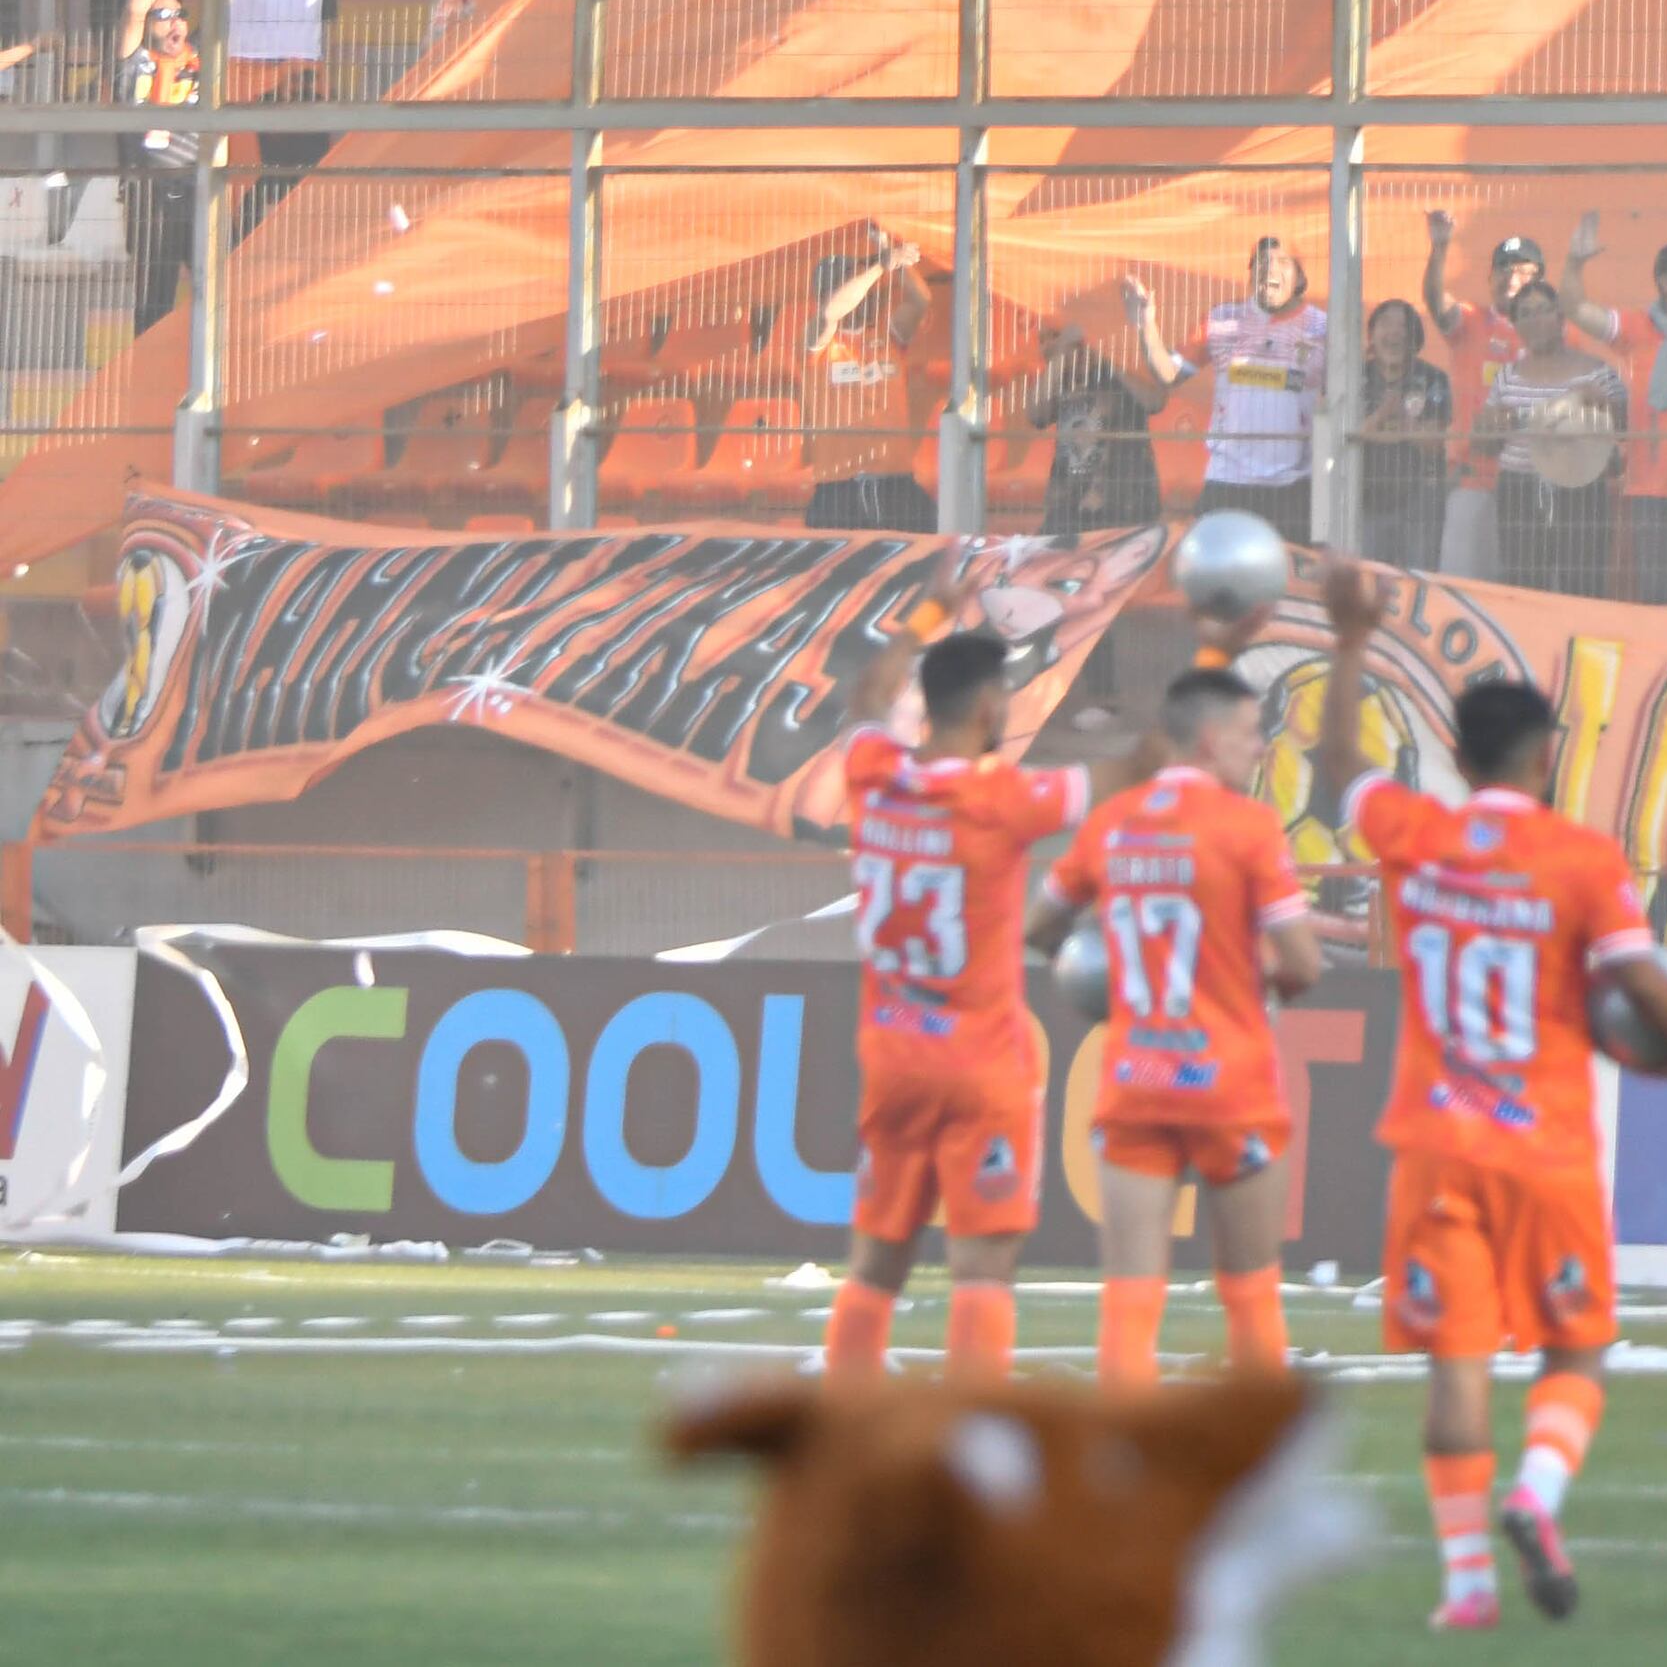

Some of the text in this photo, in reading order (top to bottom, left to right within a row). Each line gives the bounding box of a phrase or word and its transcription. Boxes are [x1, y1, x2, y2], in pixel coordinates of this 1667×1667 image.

[856, 853, 968, 979] 23
[1110, 894, 1202, 1019] 17
[1409, 923, 1539, 1063] 10
